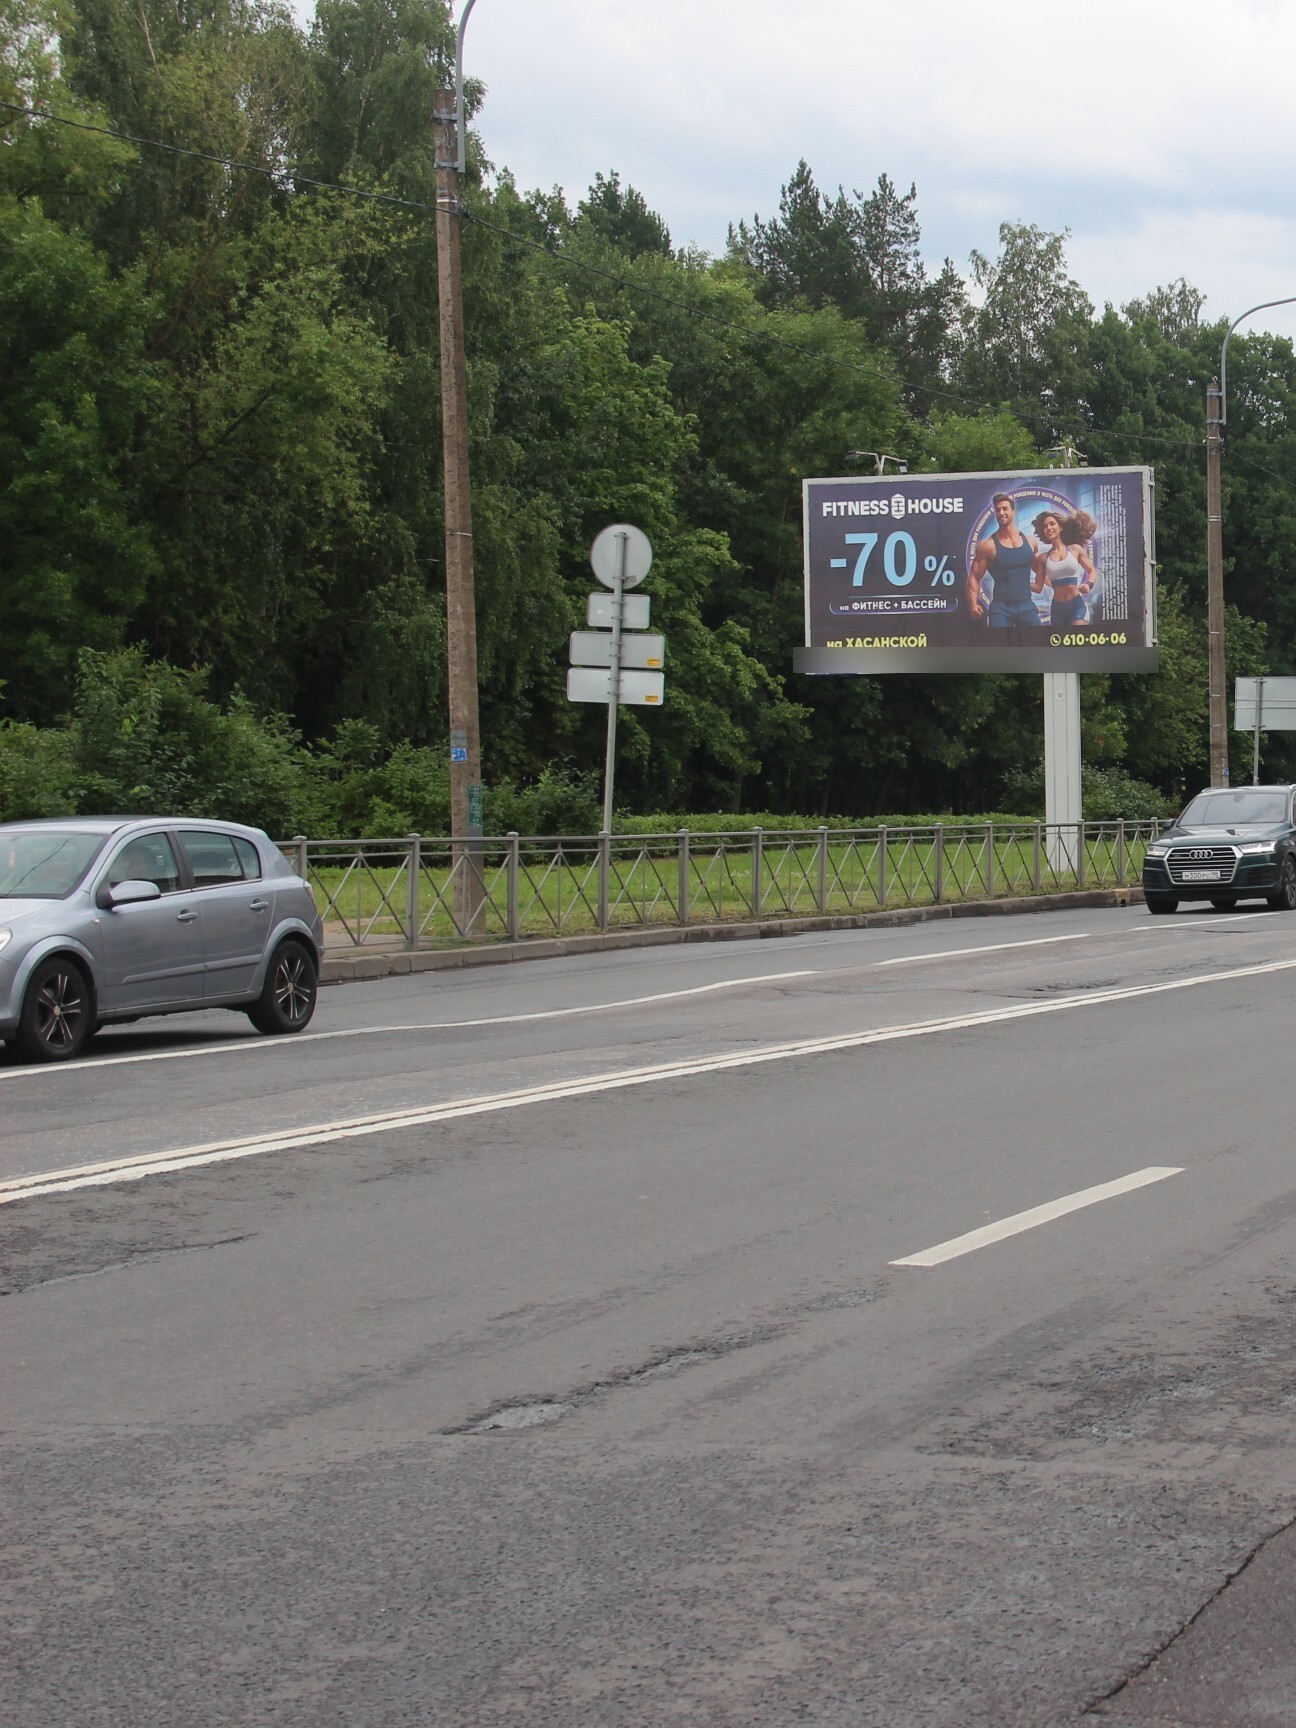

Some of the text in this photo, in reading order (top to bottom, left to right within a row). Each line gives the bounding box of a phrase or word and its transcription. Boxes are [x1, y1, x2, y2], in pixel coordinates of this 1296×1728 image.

[822, 498, 964, 517] FITNESS HOUSE
[851, 600, 891, 611] ФИТНЕС
[901, 598, 947, 610] БАССЕЙН
[826, 634, 927, 648] на ХАСАНСКОЙ
